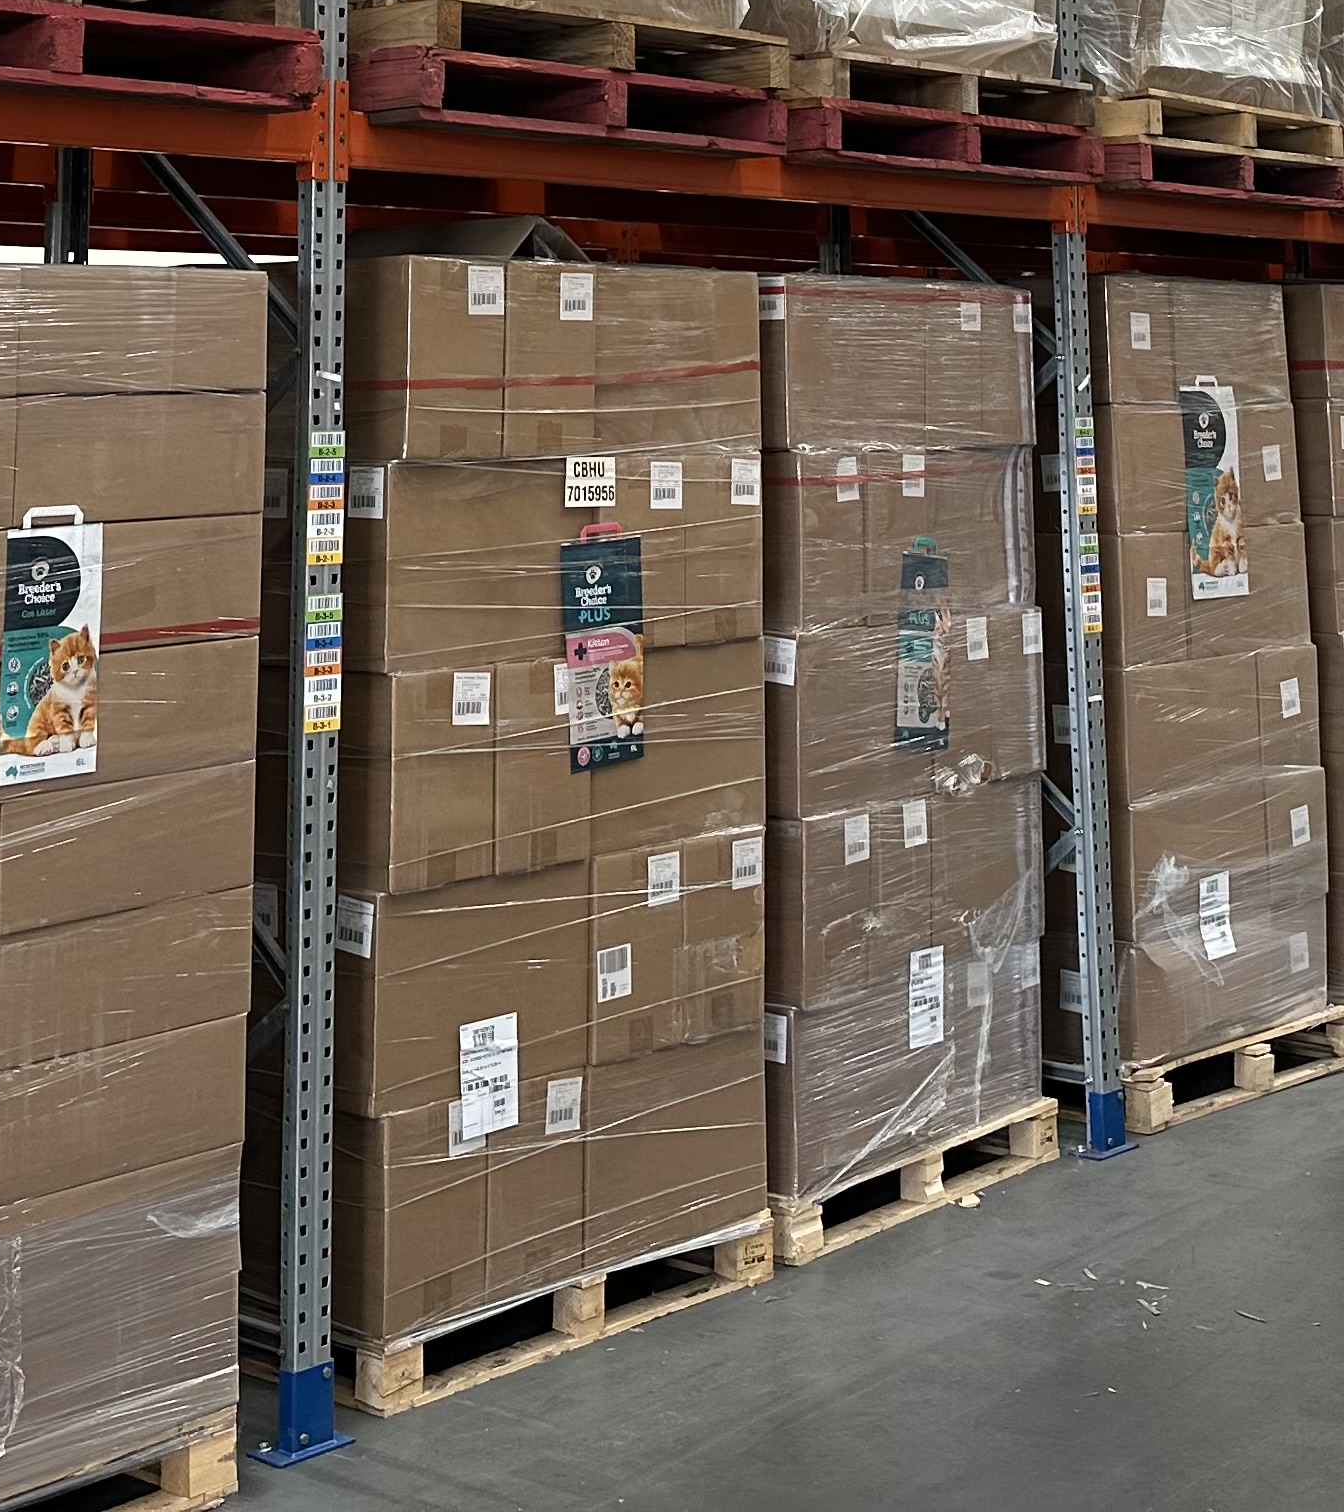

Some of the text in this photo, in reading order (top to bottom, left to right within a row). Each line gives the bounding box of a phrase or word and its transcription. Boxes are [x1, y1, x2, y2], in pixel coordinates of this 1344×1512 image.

[573, 461, 605, 478] CBHU
[567, 484, 615, 502] 7015956
[18, 581, 61, 595] Breeder's
[574, 584, 612, 598] Breeder's
[24, 593, 56, 604] Choice
[577, 607, 611, 624] PLUS
